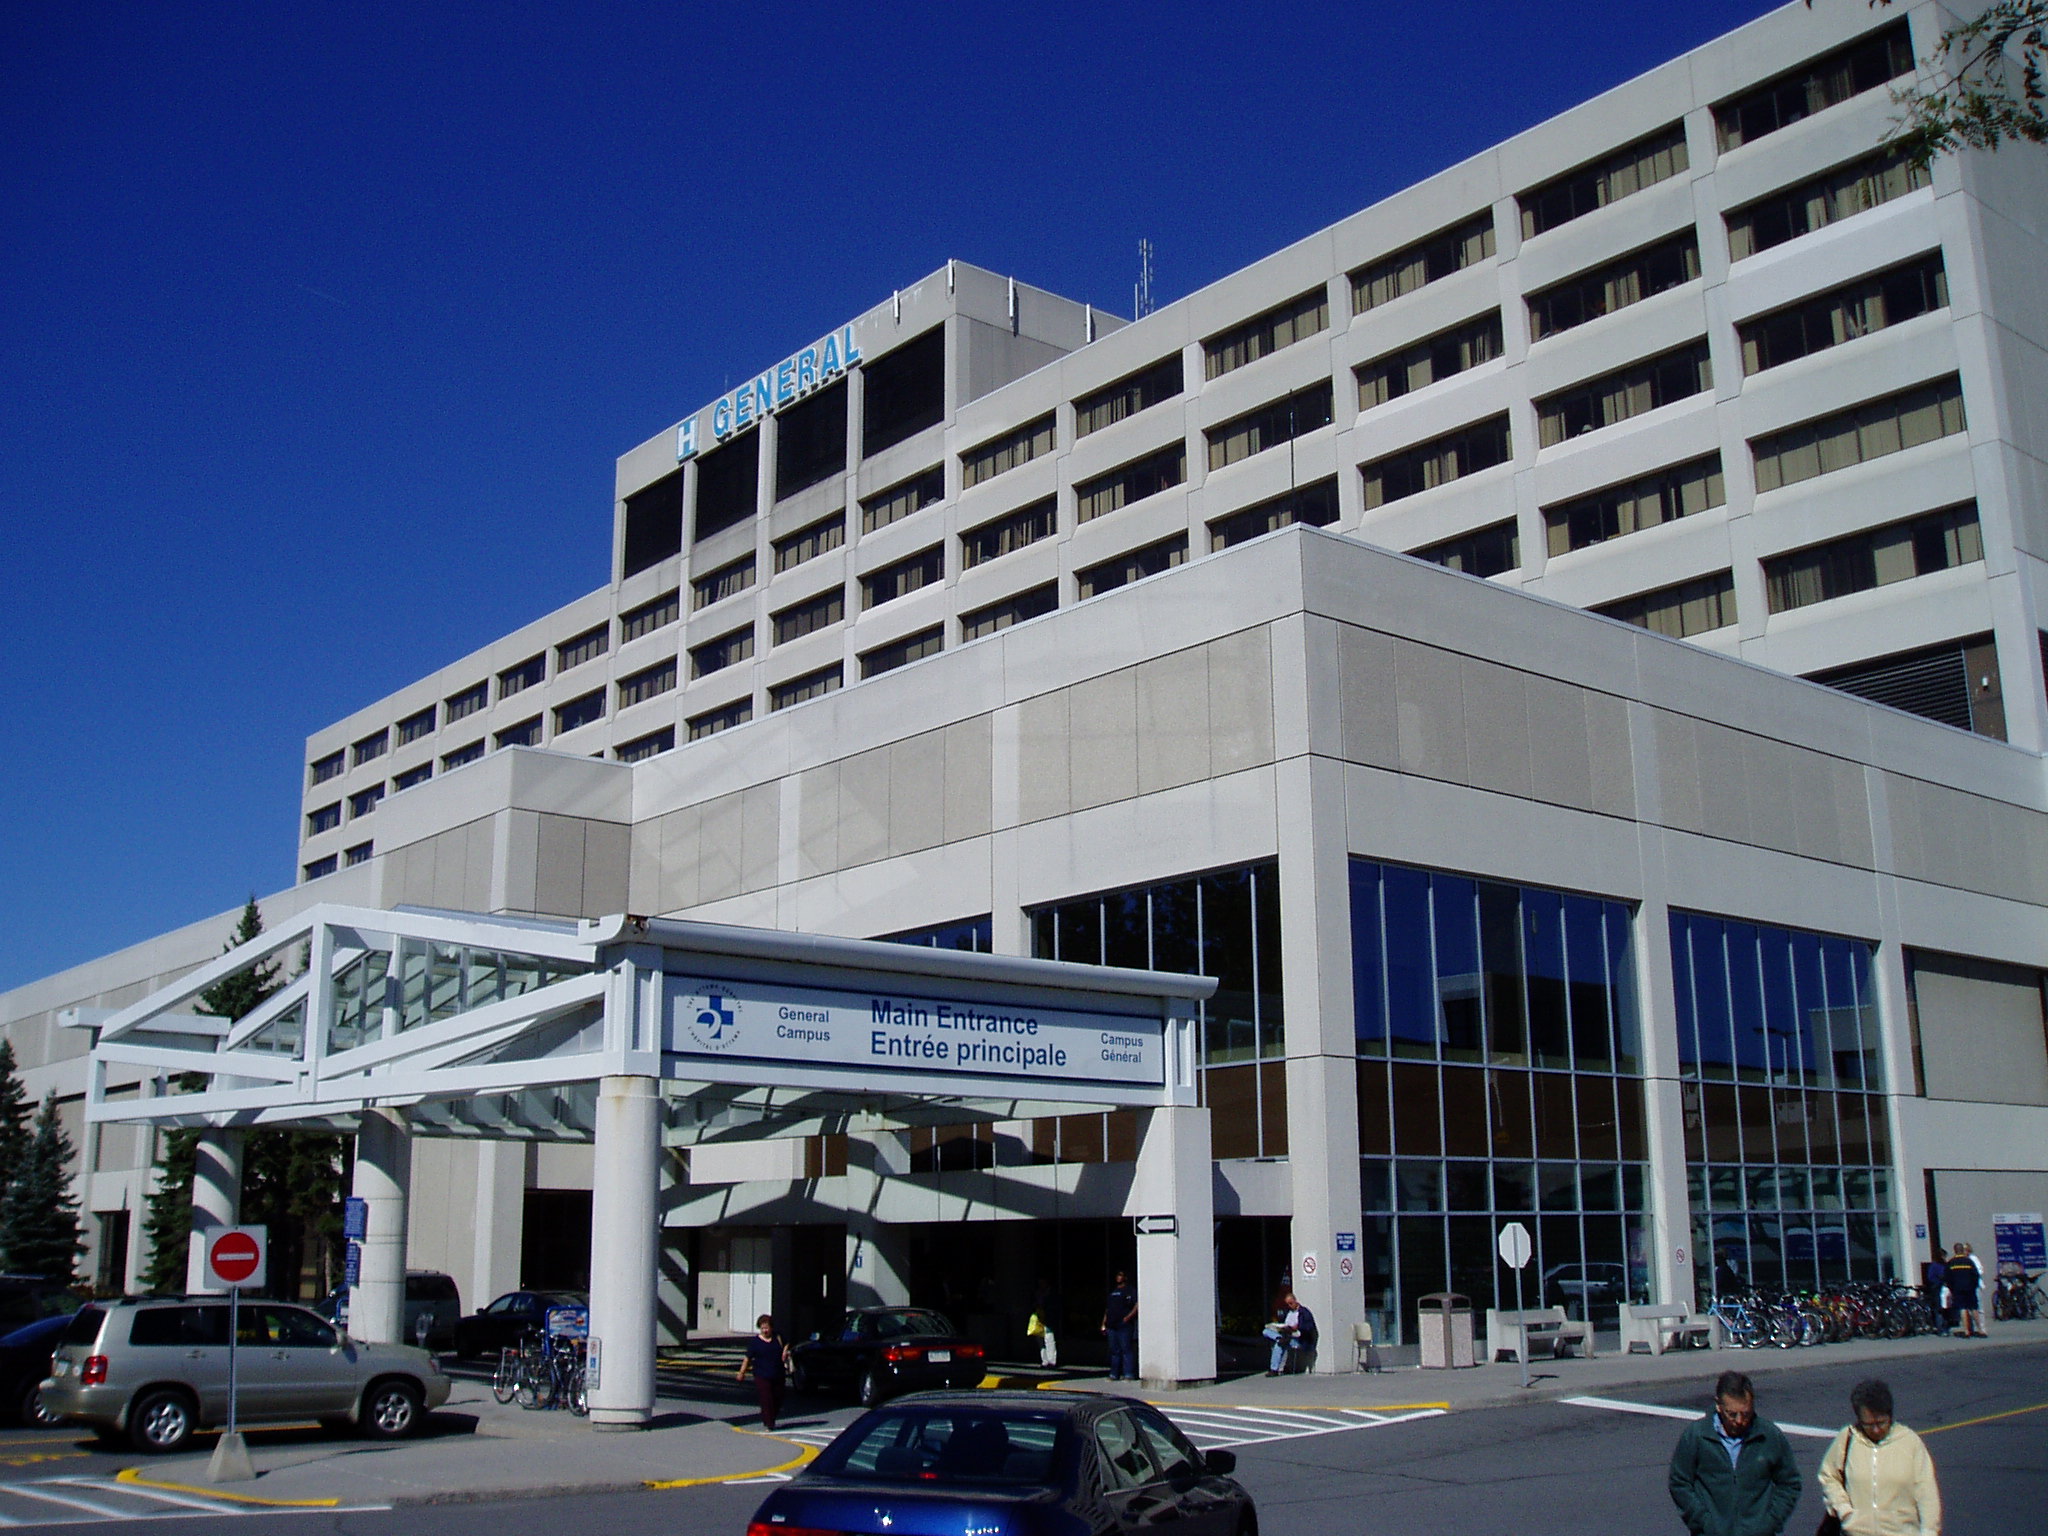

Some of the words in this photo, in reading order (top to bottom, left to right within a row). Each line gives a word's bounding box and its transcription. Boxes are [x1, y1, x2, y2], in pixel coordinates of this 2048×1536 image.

[677, 416, 698, 459] H
[712, 324, 863, 440] GENERAL
[778, 1006, 830, 1023] General
[871, 998, 928, 1027] Main
[936, 1005, 1039, 1036] Entrance
[776, 1024, 831, 1043] Campus
[1100, 1032, 1144, 1049] Campus
[871, 1030, 949, 1059] Entrée
[957, 1038, 1067, 1070] principale
[1101, 1049, 1142, 1063] Général
